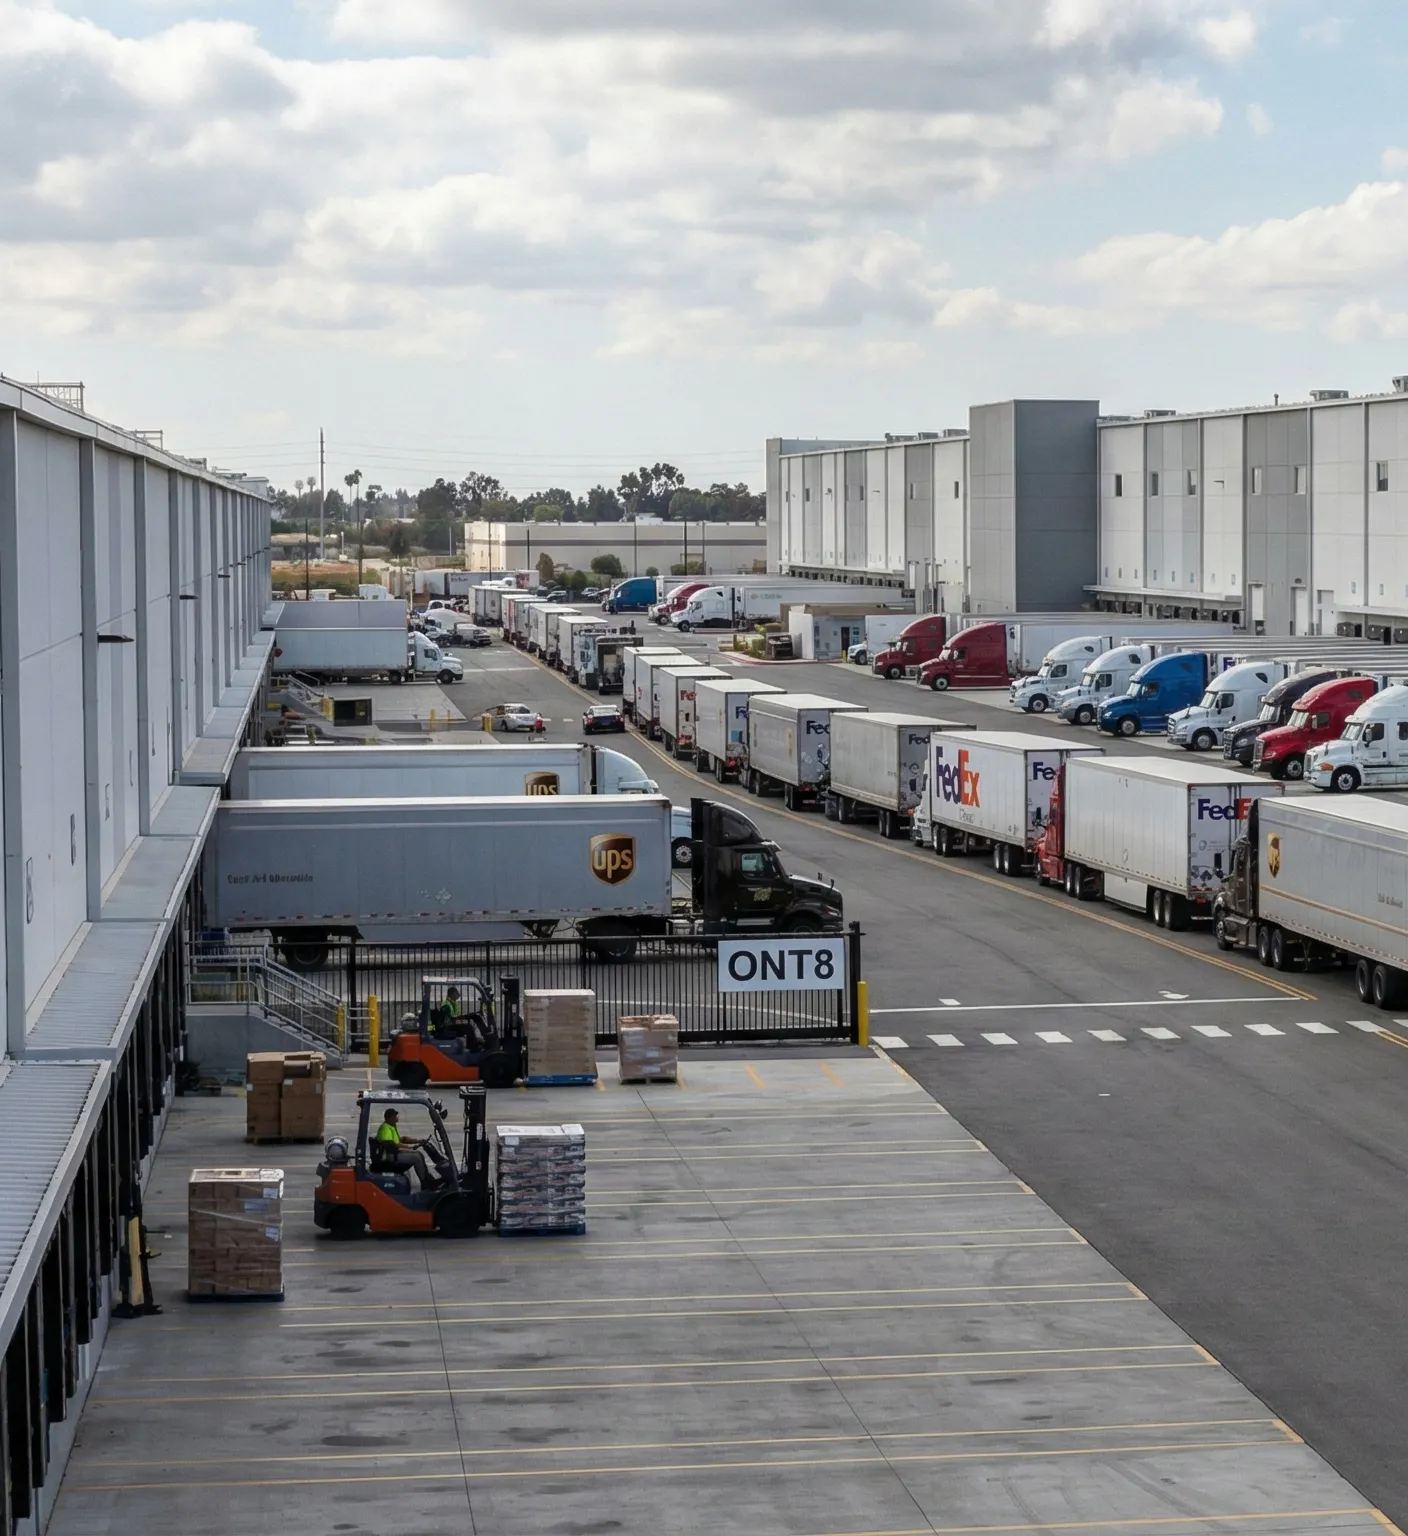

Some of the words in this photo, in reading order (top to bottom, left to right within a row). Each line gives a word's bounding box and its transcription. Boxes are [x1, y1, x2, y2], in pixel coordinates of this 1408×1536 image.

[936, 746, 980, 808] FedEx
[1198, 798, 1252, 821] FedE
[593, 849, 633, 879] ups
[728, 949, 835, 981] ONT8
